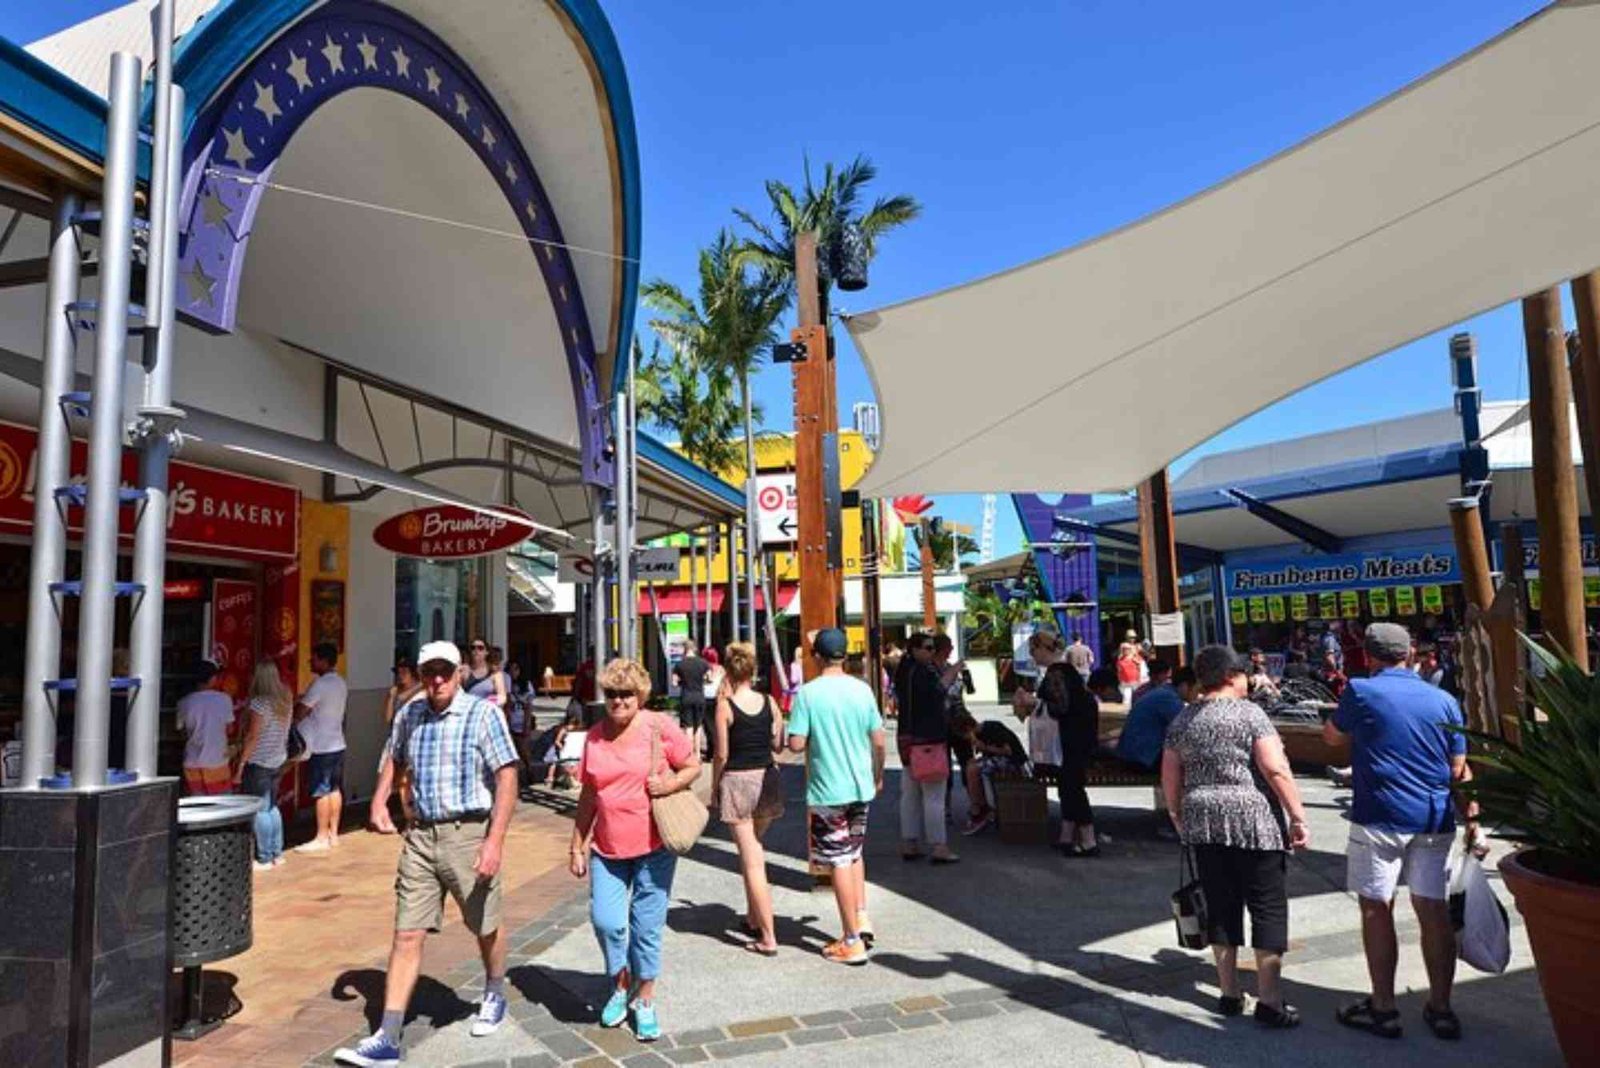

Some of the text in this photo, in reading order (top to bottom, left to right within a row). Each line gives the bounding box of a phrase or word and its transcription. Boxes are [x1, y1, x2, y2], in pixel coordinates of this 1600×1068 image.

[202, 497, 287, 528] BAKERY
[421, 538, 488, 554] BAKERY
[1234, 554, 1450, 588] Franberne Meats
